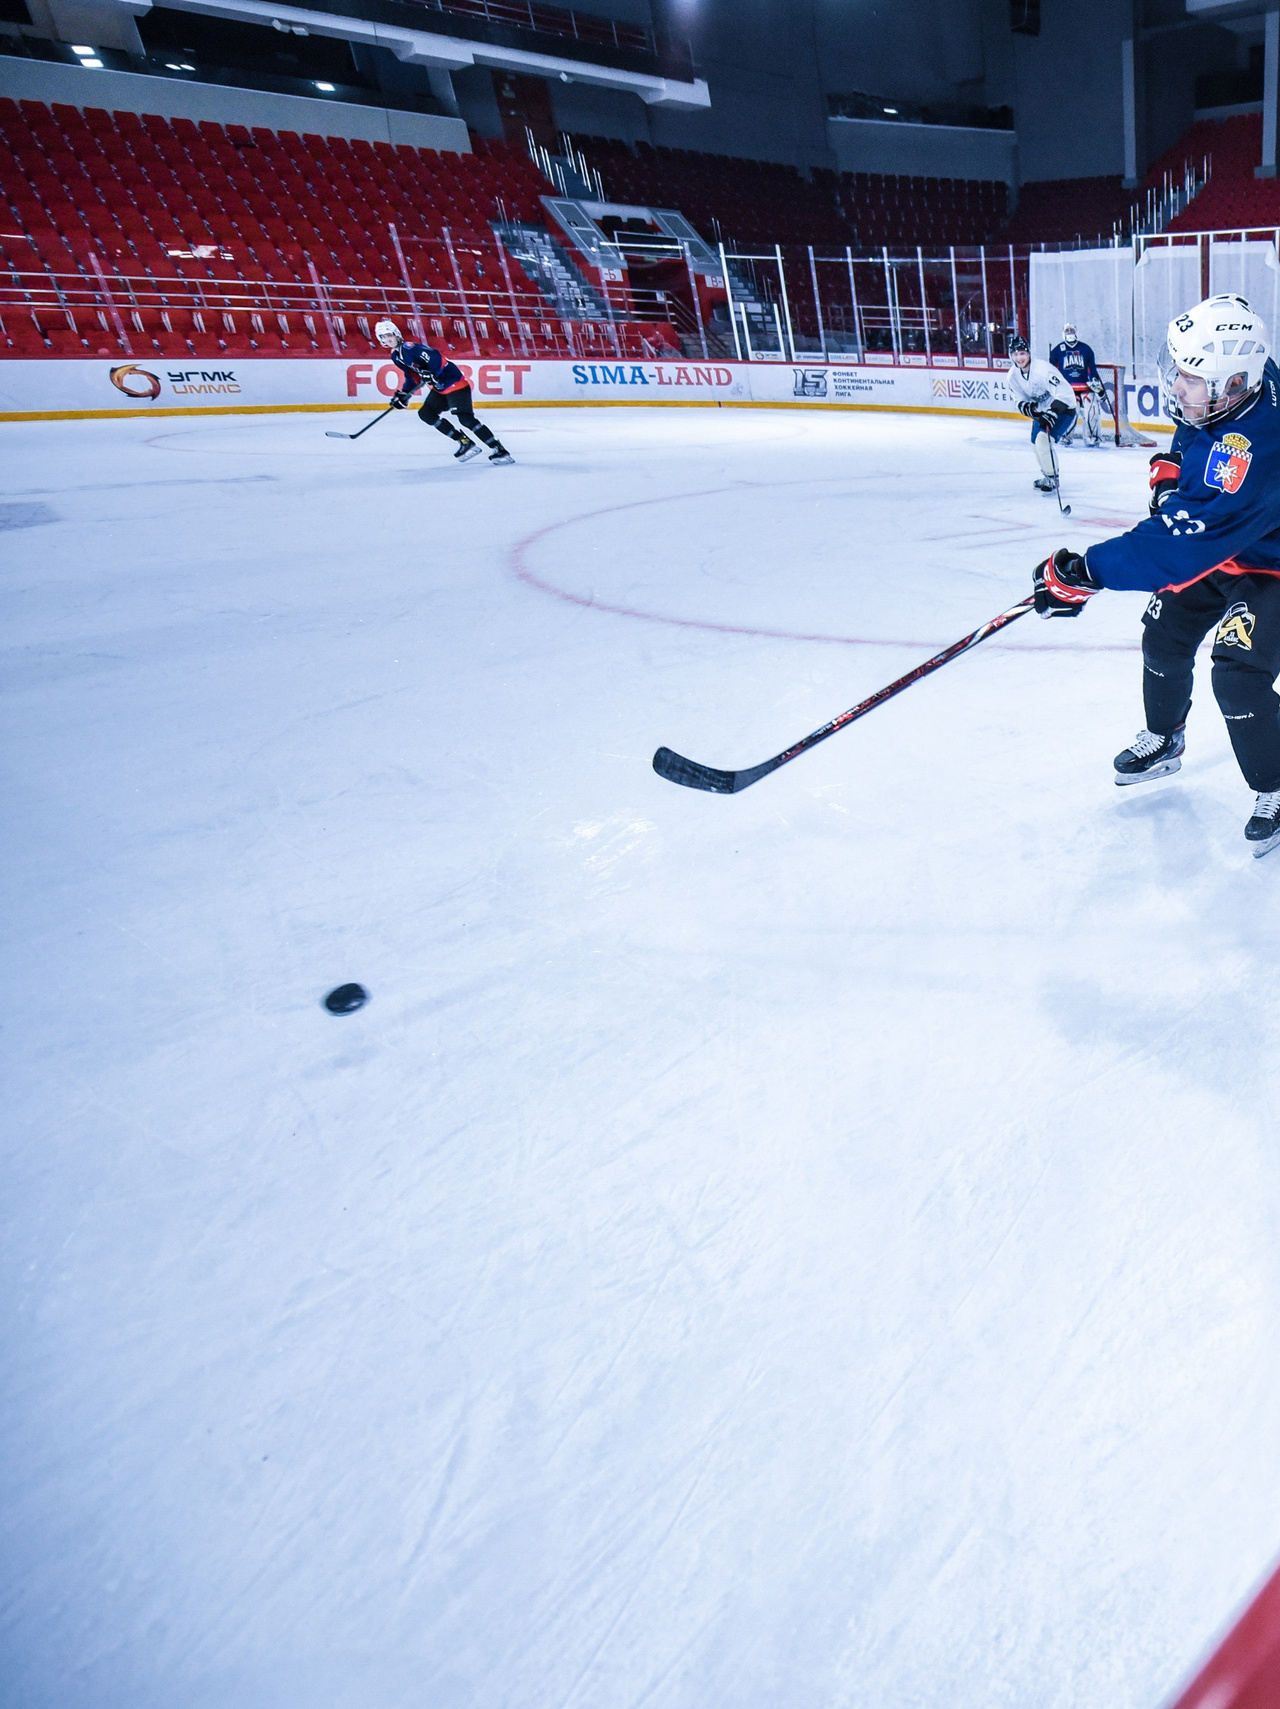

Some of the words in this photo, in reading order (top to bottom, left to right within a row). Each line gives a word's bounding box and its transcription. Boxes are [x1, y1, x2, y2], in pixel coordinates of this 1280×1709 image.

[1175, 314, 1194, 333] 23
[1215, 323, 1253, 332] CCM
[167, 371, 237, 382] УГМК
[346, 363, 532, 397] FOBET
[573, 365, 733, 387] SIMA-LAND
[172, 384, 242, 395] UMMC
